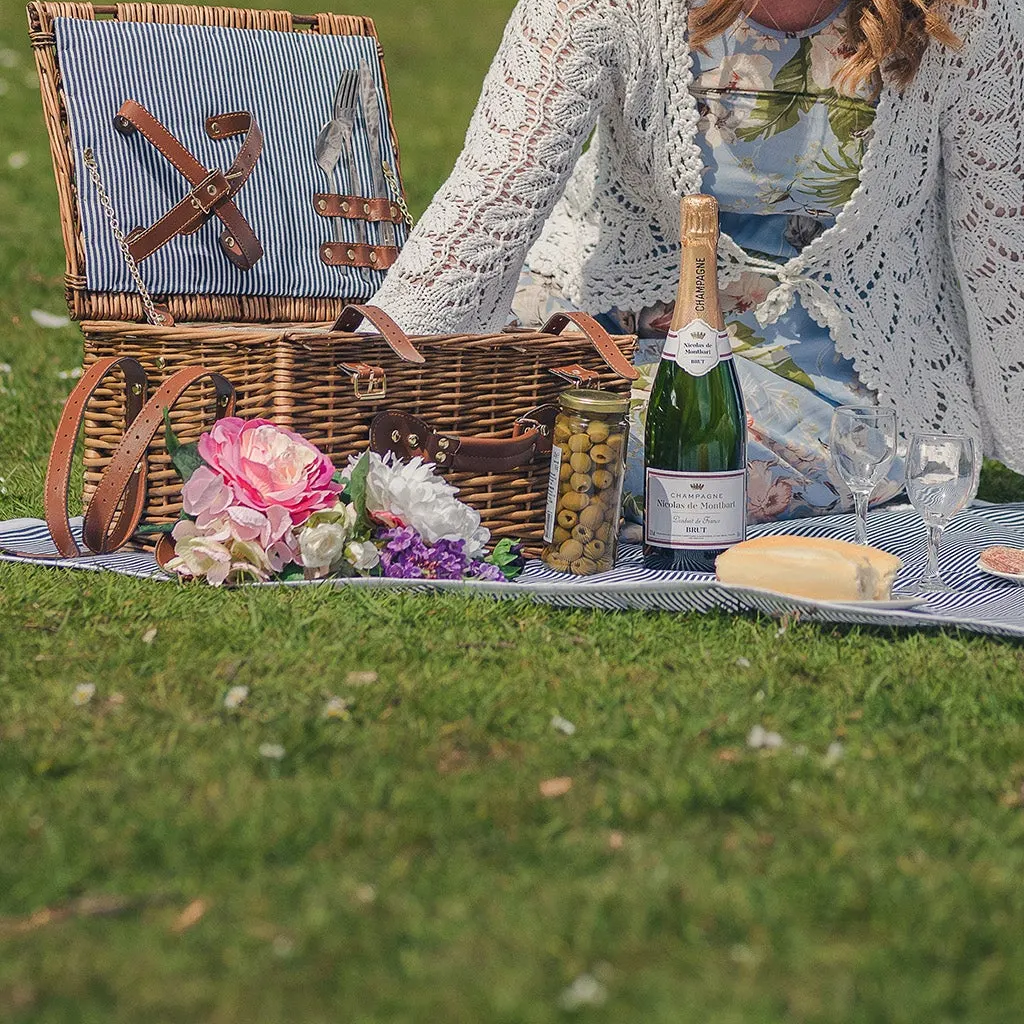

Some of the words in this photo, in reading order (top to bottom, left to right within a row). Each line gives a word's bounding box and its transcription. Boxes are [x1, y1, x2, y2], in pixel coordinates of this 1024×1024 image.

[695, 257, 706, 312] CHAMPAGNE
[656, 498, 686, 509] Nicolas
[687, 501, 698, 509] de
